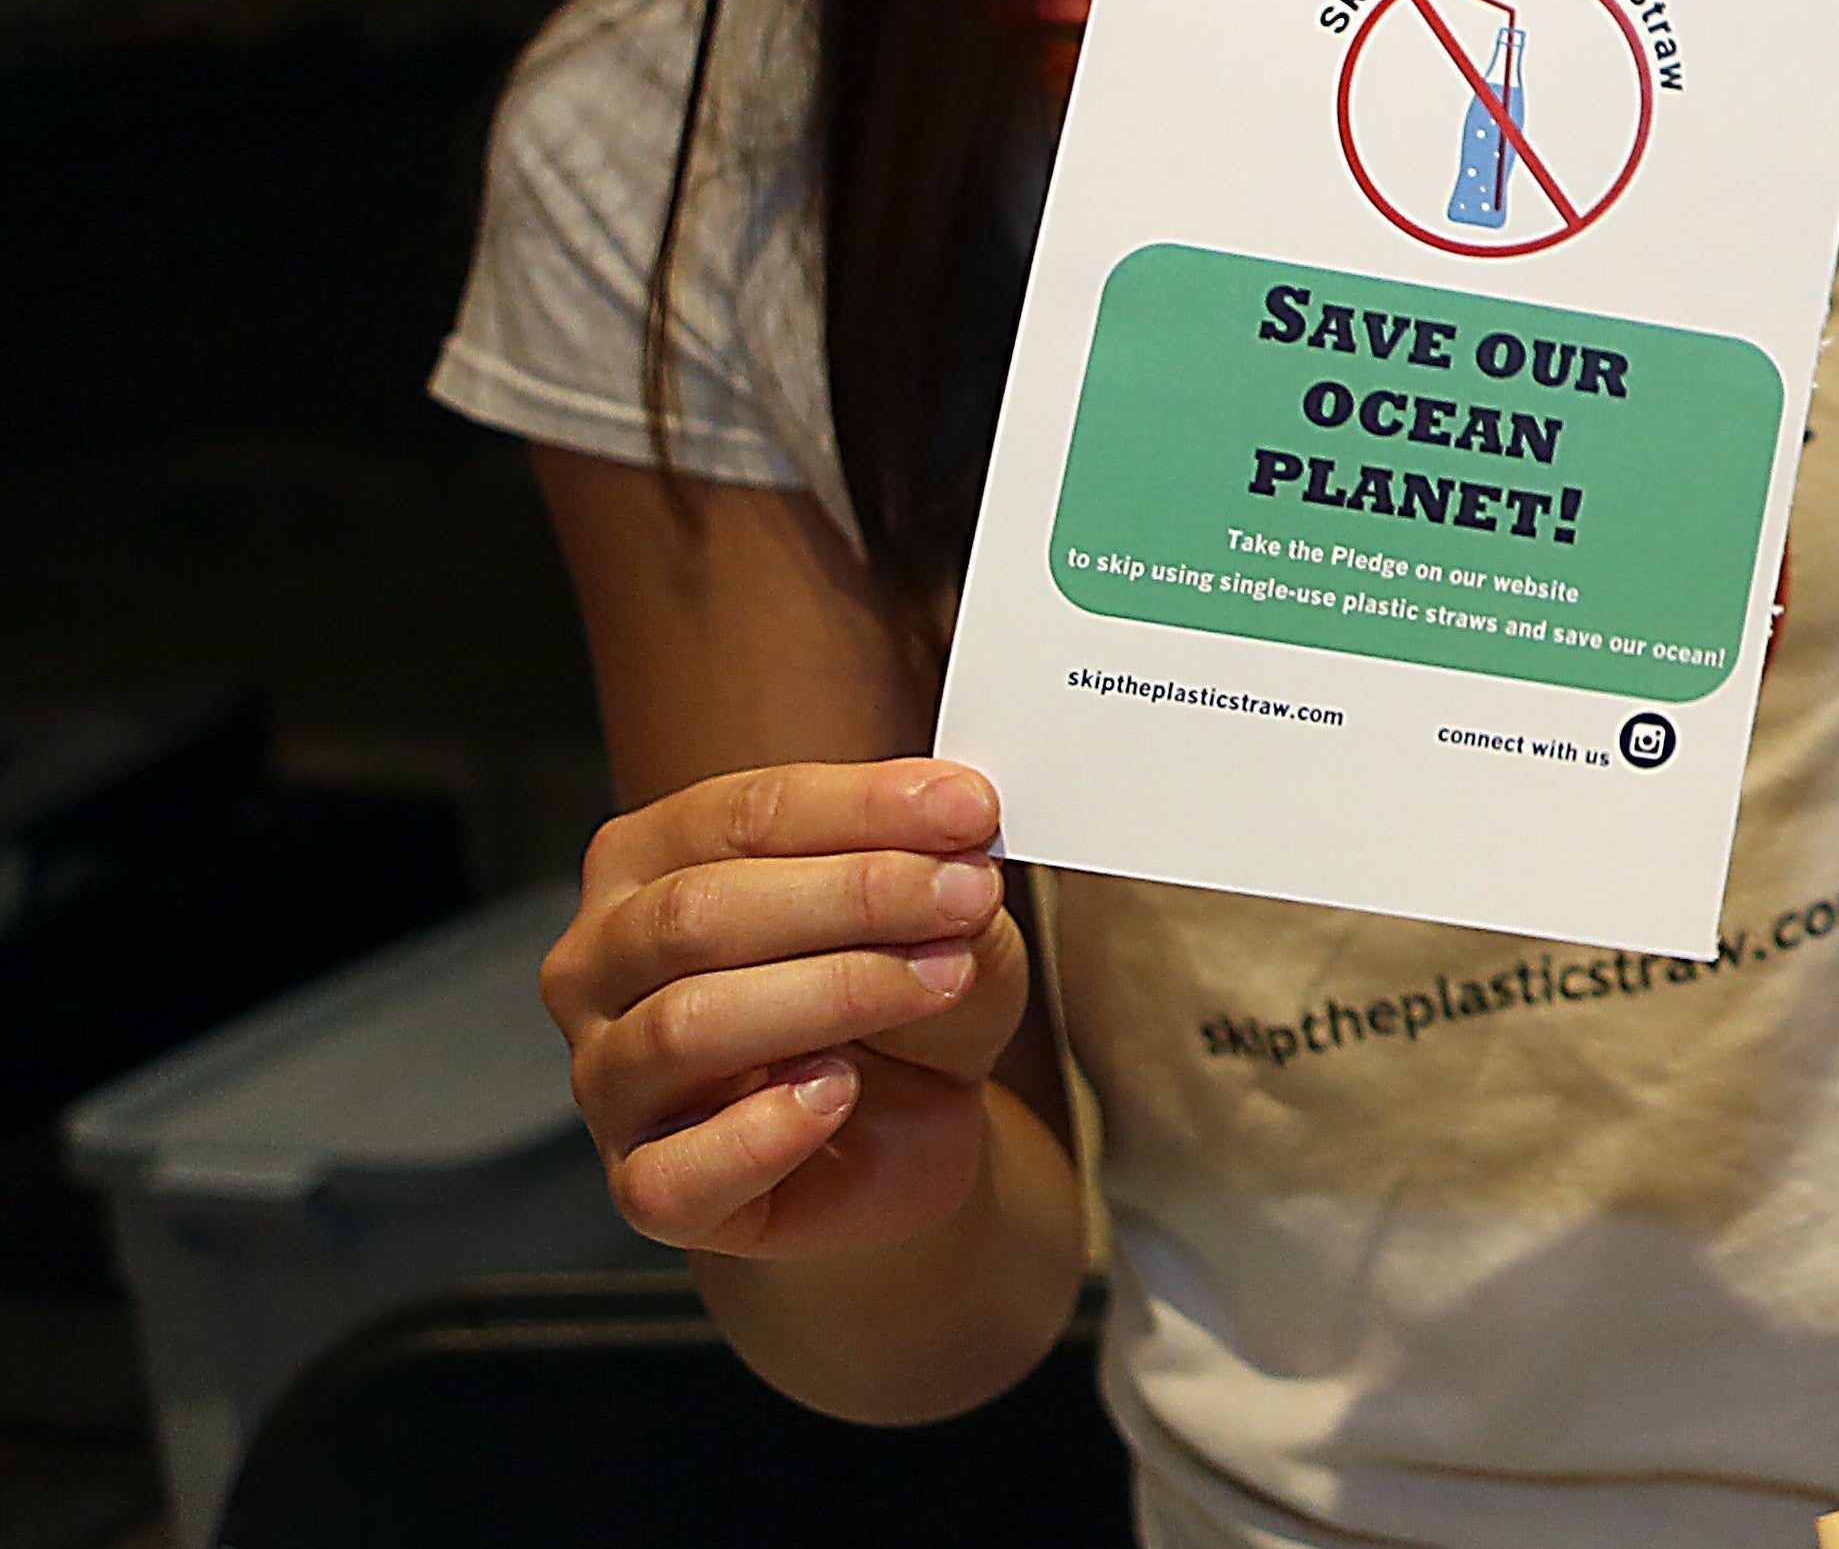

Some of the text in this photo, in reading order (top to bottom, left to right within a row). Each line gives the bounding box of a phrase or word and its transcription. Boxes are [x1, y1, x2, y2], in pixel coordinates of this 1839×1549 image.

[1258, 285, 1630, 399] SAVE OUR
[1303, 380, 1564, 464] OCEAN
[1248, 448, 1583, 545] PLANET!
[1227, 528, 1579, 603] Take the Pledge on our website
[1067, 547, 1726, 669] to skip using single-use plastic straws and save our ocean!
[1067, 667, 1345, 726] skiptheplasticstraw.com
[1437, 725, 1611, 767] connect with us
